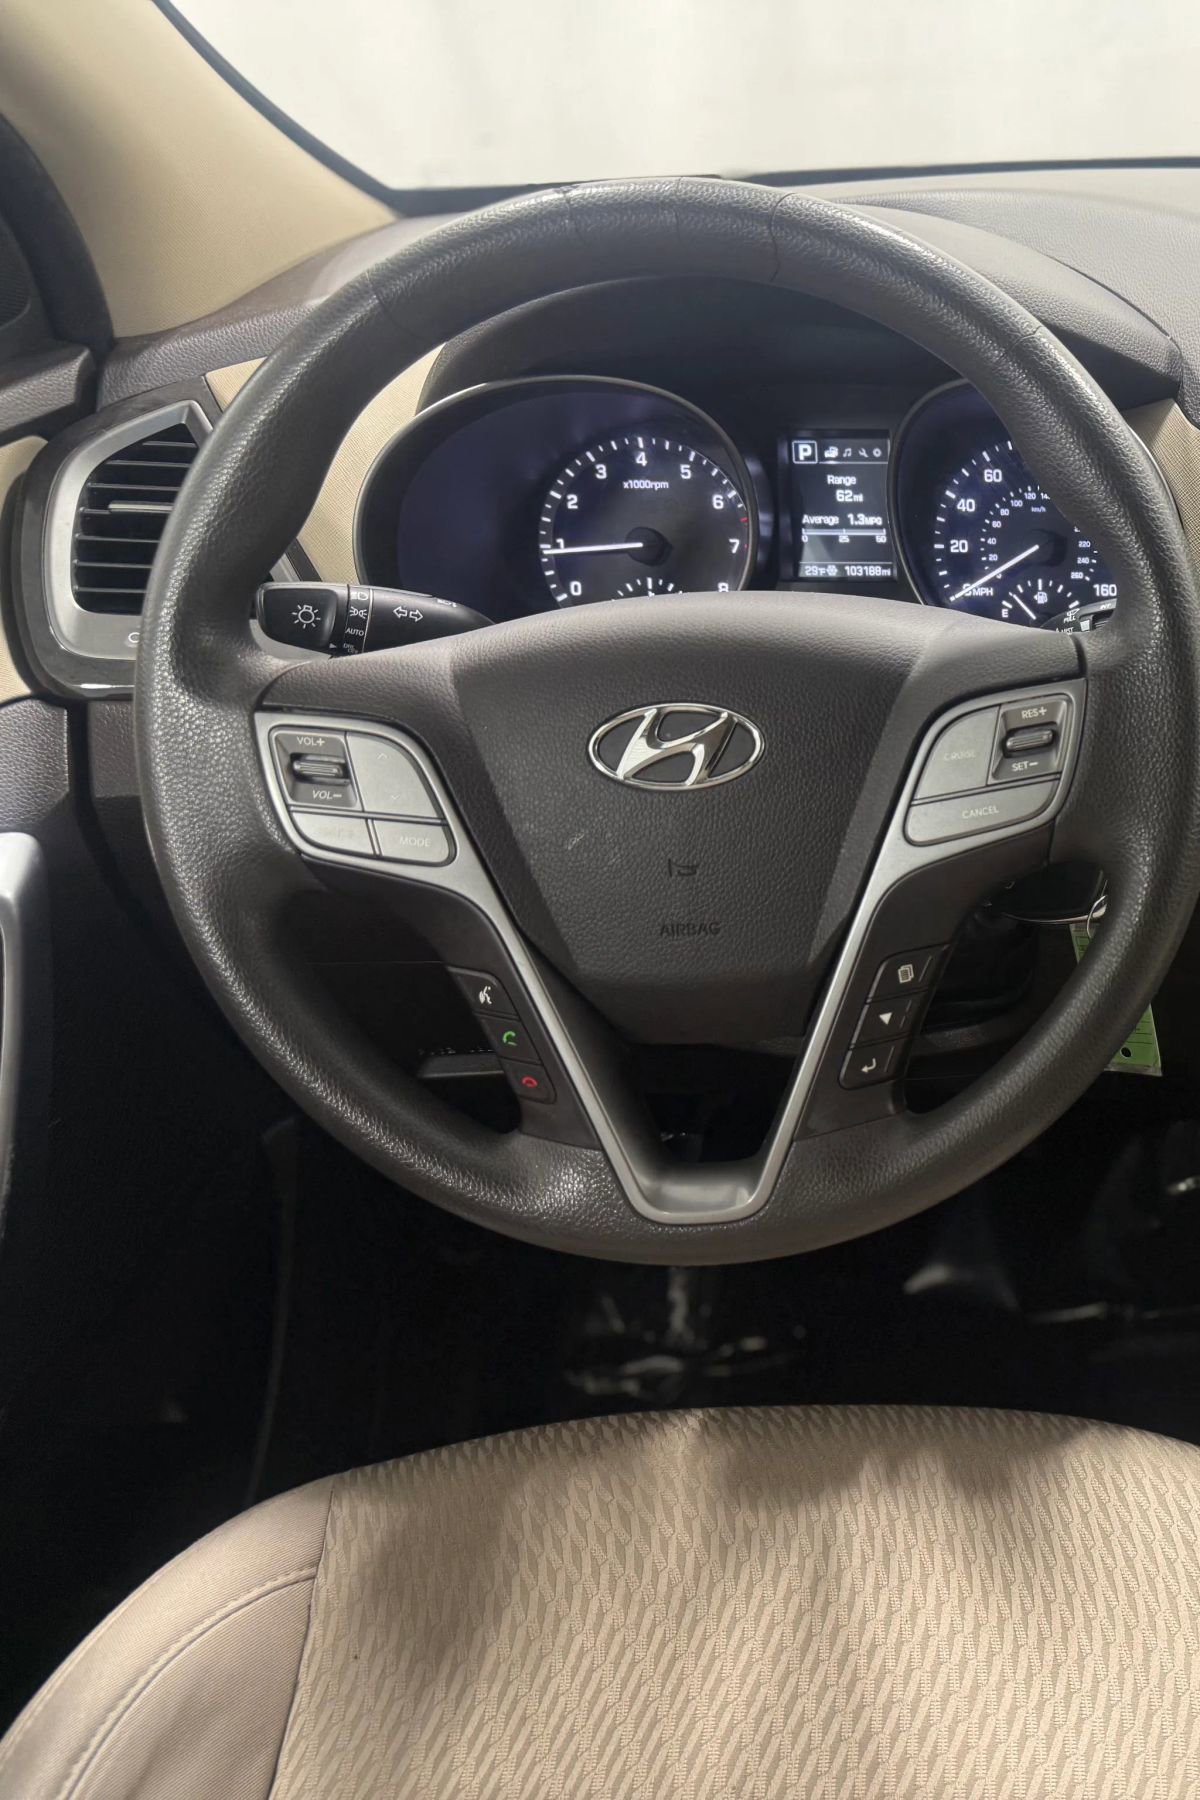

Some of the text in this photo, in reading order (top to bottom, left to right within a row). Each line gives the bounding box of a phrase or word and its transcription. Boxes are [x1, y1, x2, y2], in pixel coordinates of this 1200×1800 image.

[799, 443, 812, 461] P
[636, 452, 647, 467] 4
[596, 465, 607, 480] 3
[680, 465, 692, 480] 5
[984, 469, 1003, 483] 60
[623, 480, 669, 490] x1000rpm
[827, 474, 857, 486] Range
[567, 495, 578, 510] 2
[712, 495, 724, 510] 6
[1024, 492, 1037, 500] 120
[957, 499, 975, 512] 40
[1010, 500, 1023, 508] 100
[802, 514, 840, 526] Average
[729, 538, 740, 553] 7
[950, 540, 968, 553] 20
[987, 537, 997, 545] 40
[988, 553, 998, 561] 20
[570, 581, 582, 596] 0
[973, 587, 994, 596] MPH
[1093, 583, 1117, 597] 160
[1001, 608, 1009, 618] E
[345, 627, 365, 637] AUTO
[1021, 706, 1048, 720] RES+
[296, 735, 326, 748] VOL+
[311, 789, 343, 801] VOL-
[962, 806, 999, 818] CANCEL
[399, 836, 432, 848] MODE
[660, 921, 721, 938] AIRBAG
